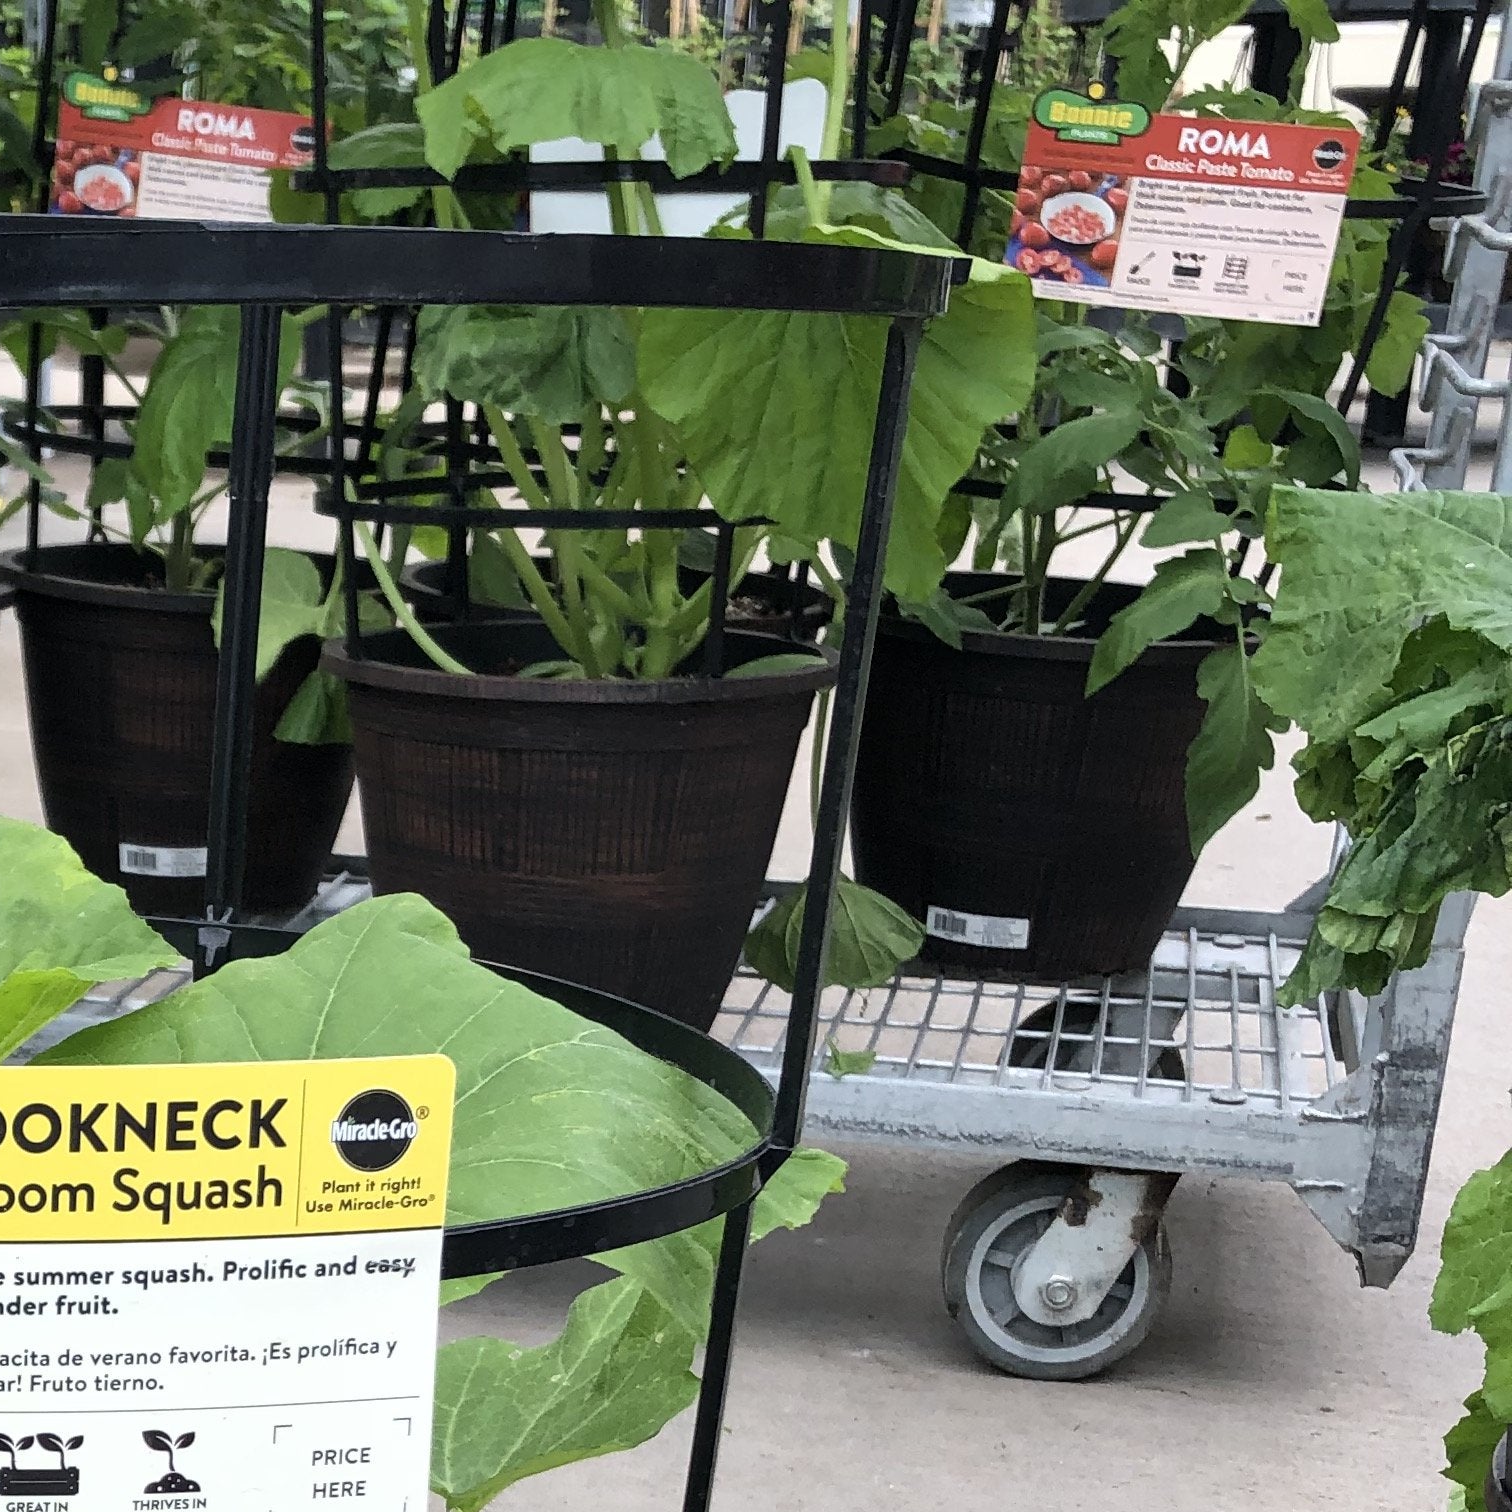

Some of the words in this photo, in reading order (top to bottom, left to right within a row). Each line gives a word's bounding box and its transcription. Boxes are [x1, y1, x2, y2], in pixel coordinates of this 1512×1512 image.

[178, 109, 256, 140] ROMA
[1178, 127, 1271, 159] ROMA
[1145, 154, 1196, 173] Classic
[1197, 158, 1238, 177] Paste
[1240, 162, 1295, 182] Tomato
[331, 1118, 418, 1142] Miracle-Gro
[113, 1165, 283, 1225] Squash
[322, 1180, 361, 1194] Plant
[365, 1180, 376, 1192] it
[380, 1177, 421, 1195] right!
[306, 1200, 333, 1213] Use
[14, 1270, 114, 1286] summer
[122, 1263, 214, 1290] squash.
[223, 1258, 307, 1281] Prolific
[314, 1255, 357, 1276] and
[365, 1257, 416, 1278] easy
[55, 1295, 119, 1315] fruit.
[57, 1349, 83, 1366] de
[90, 1350, 161, 1366] verano
[169, 1345, 256, 1364] favorita.
[298, 1338, 380, 1363] prolífica
[386, 1340, 398, 1358] y
[30, 1375, 87, 1392] Fruto
[94, 1375, 164, 1391] tierno.
[312, 1447, 371, 1466] PRICE
[312, 1481, 366, 1498] HERE
[6, 1502, 50, 1512] GREAT
[54, 1502, 68, 1512] IN
[133, 1499, 189, 1511] THRIVES
[192, 1499, 207, 1509] IN
